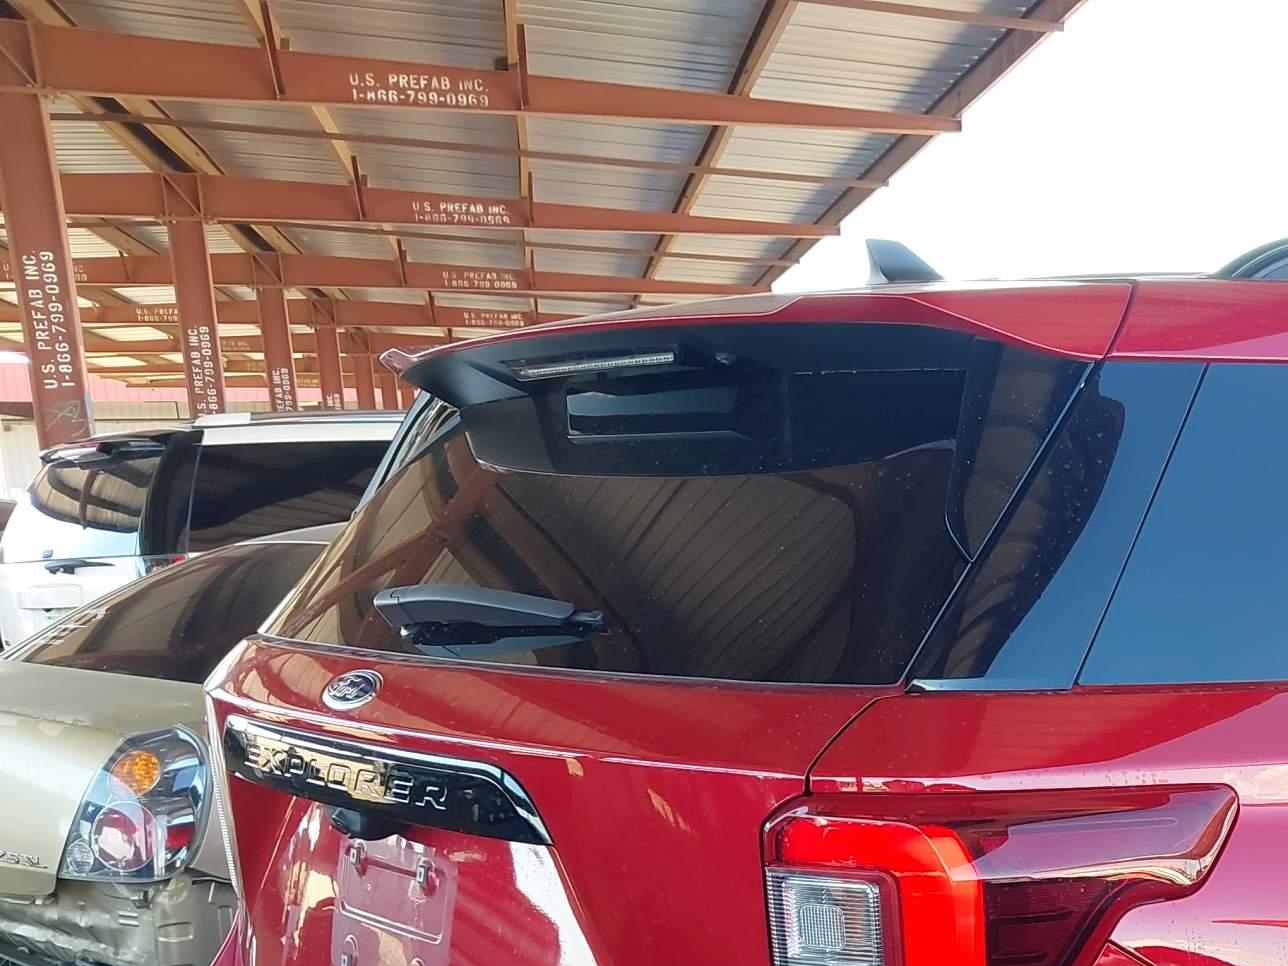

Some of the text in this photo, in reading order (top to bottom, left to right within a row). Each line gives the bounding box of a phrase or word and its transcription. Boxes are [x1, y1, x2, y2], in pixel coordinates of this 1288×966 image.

[349, 73, 489, 92] U.S. PREFAB INC.
[352, 88, 489, 108] 1-866-799-0969
[440, 201, 484, 214] PREFAB
[22, 250, 59, 389] U.S. PREFAB INC.
[39, 251, 76, 387] 1-866-799-0969
[187, 325, 200, 346] INC.
[190, 351, 205, 394] PREFAB
[199, 326, 218, 414] -866-799-0969
[244, 746, 448, 811] EXPLORER
